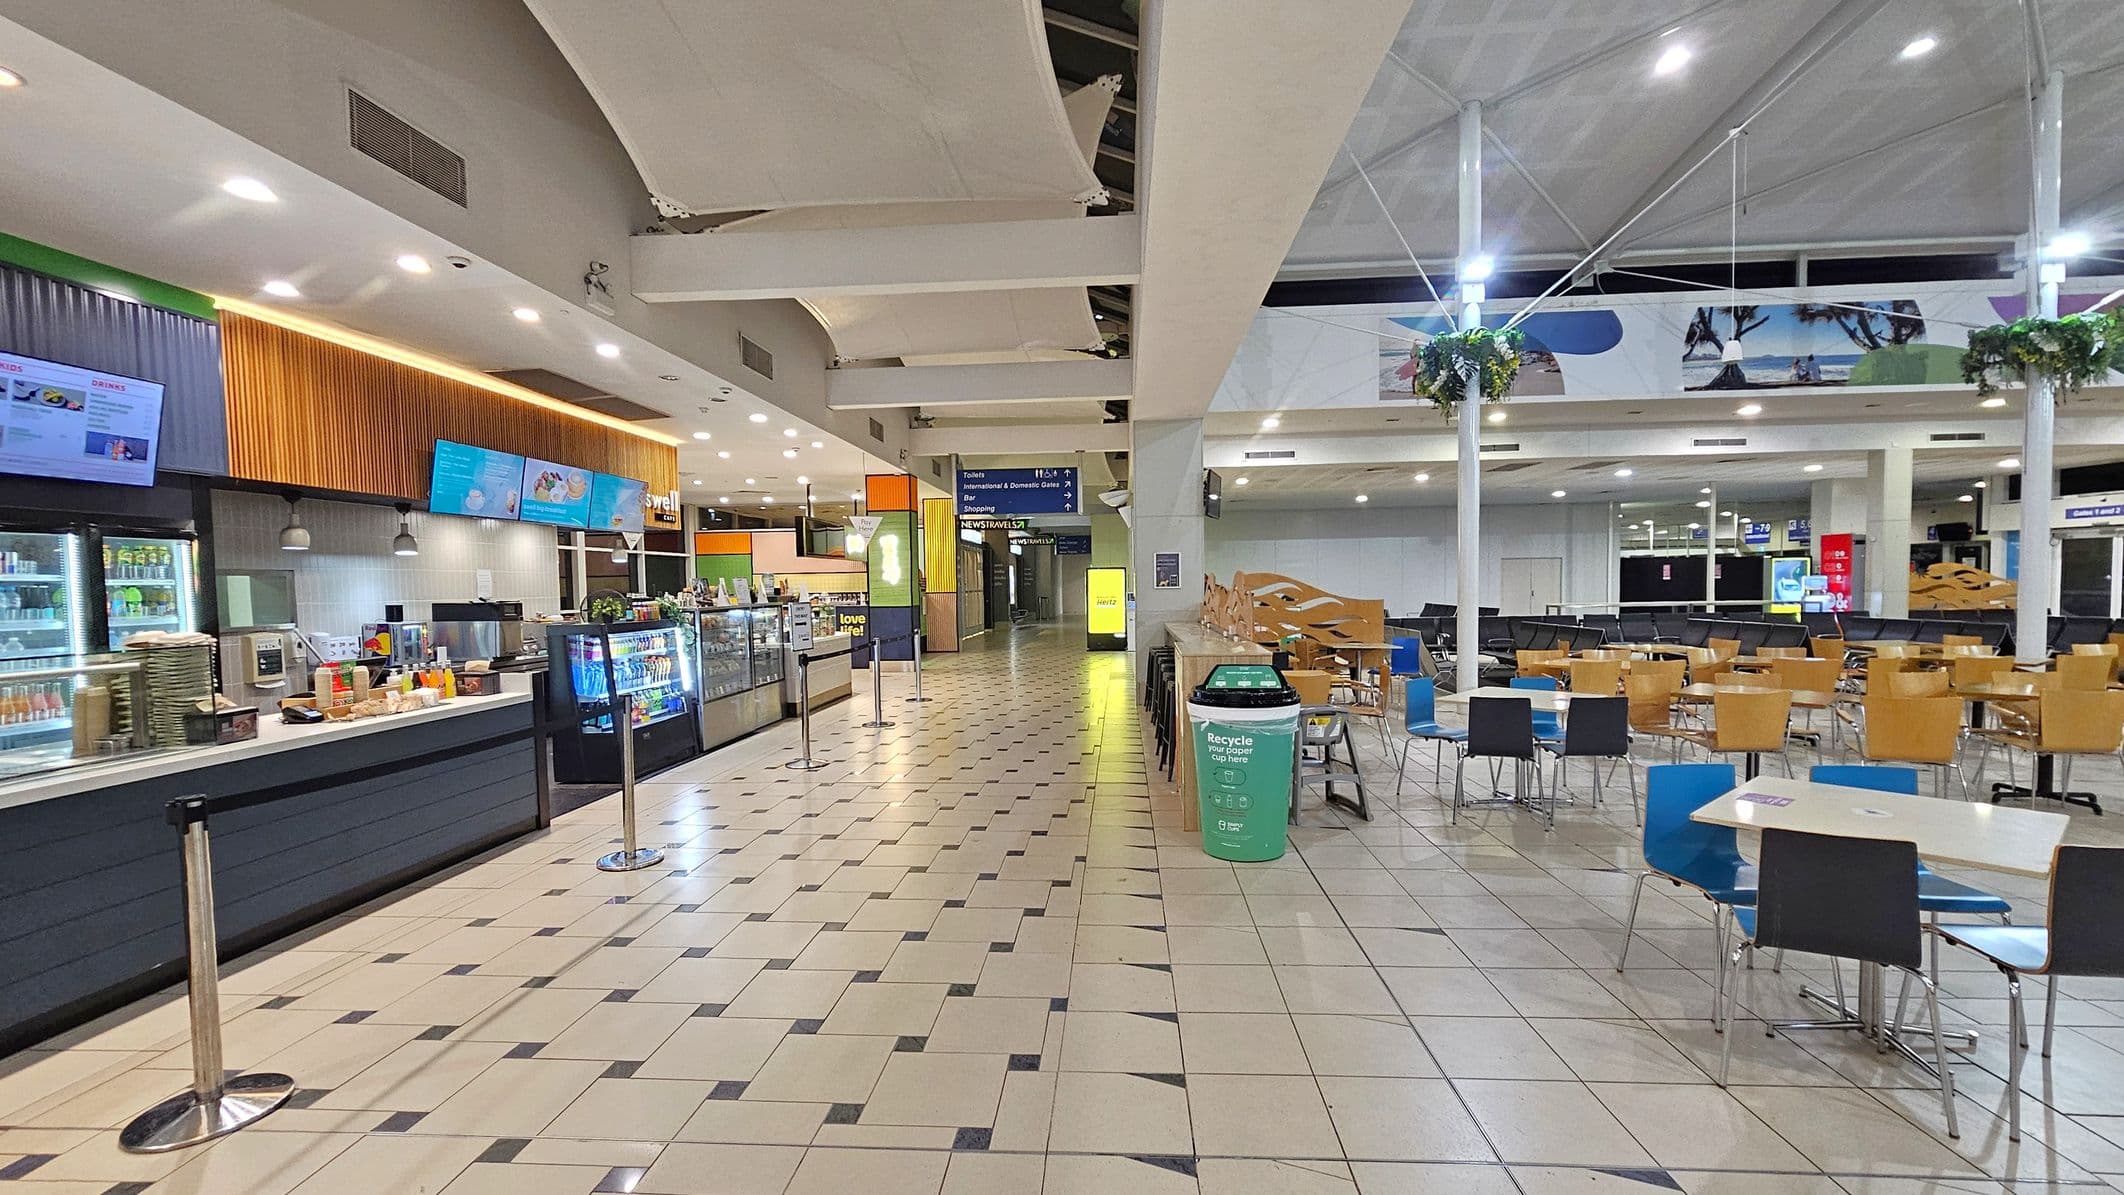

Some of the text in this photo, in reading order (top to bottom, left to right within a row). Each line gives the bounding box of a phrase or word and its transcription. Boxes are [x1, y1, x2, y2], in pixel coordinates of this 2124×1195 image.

[92, 380, 126, 391] DRINKS
[963, 471, 985, 479] Toilets
[963, 482, 1003, 490] International
[1010, 481, 1040, 489] Domestic
[645, 490, 680, 512] swell
[963, 505, 996, 513] Shopping
[860, 518, 871, 526] Pay
[960, 520, 1017, 529] NEWSTRAVELS
[840, 614, 866, 624] love
[840, 625, 864, 636] life!
[1207, 732, 1253, 747] Recycle
[1208, 745, 1253, 755] your paper
[1211, 754, 1248, 763] cup here
